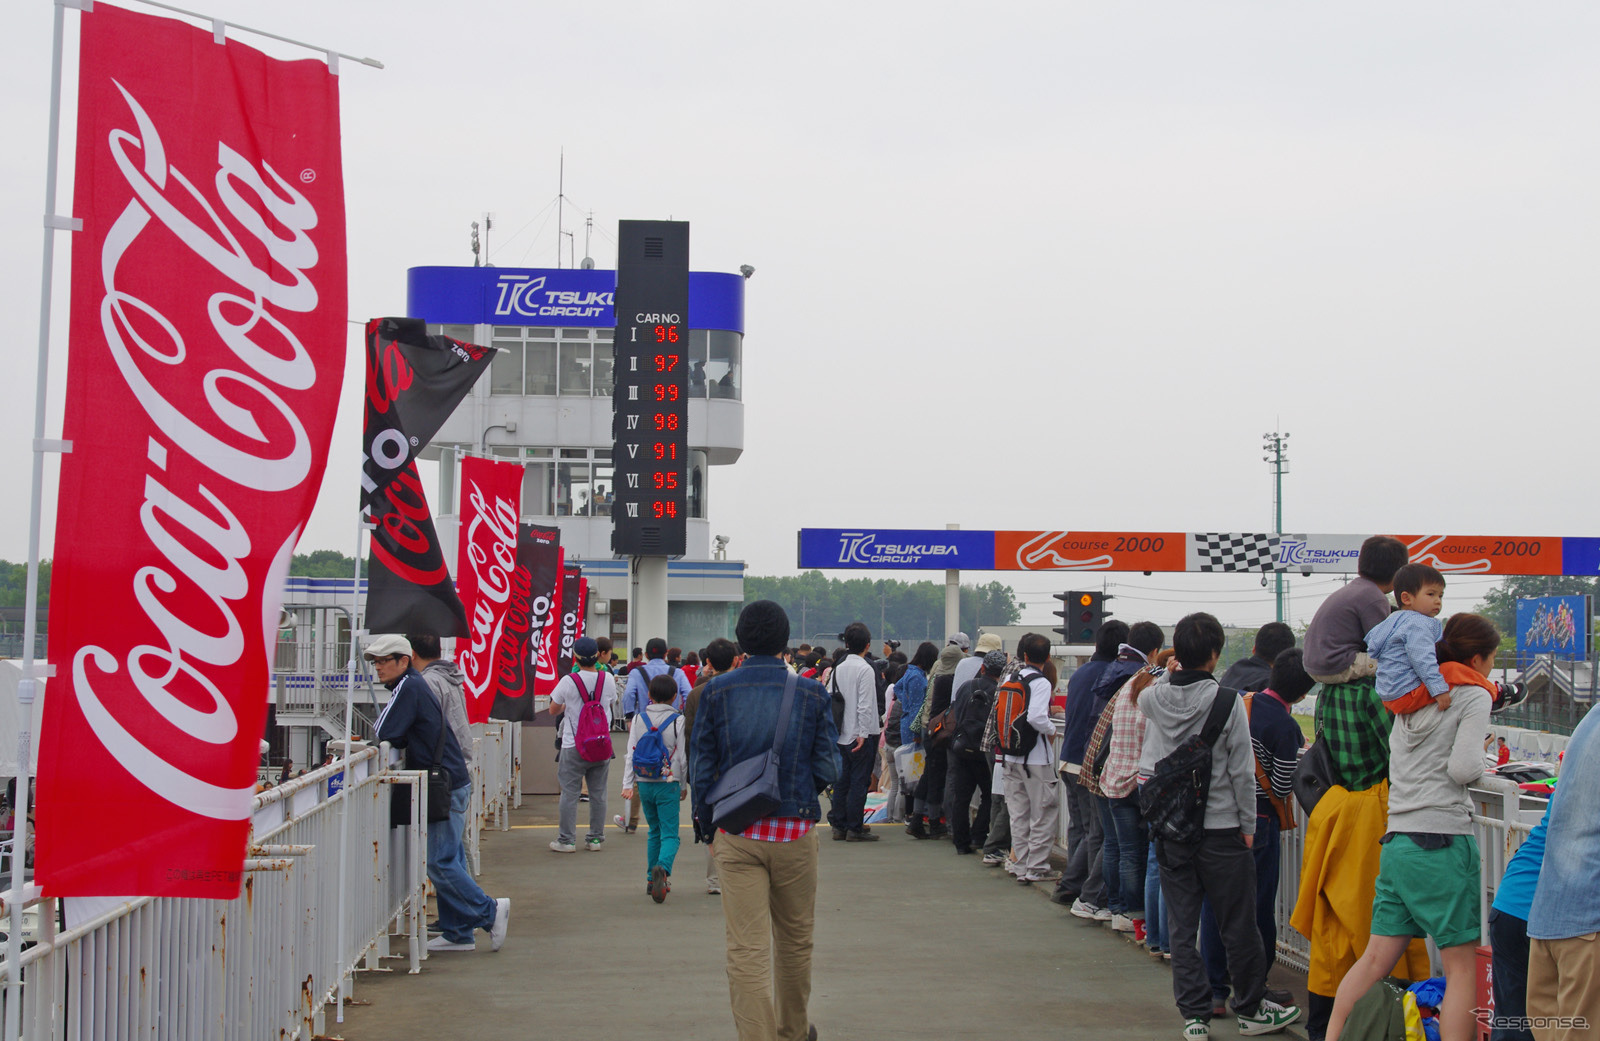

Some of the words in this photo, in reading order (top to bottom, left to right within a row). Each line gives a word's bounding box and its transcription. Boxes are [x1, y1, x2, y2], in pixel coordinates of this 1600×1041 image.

[635, 313, 660, 324] CAR
[661, 313, 681, 324] NO.
[654, 325, 679, 343] 96
[654, 354, 679, 372] 97
[653, 384, 679, 401] 99
[653, 413, 678, 431] 98
[72, 77, 320, 821] Coca-Cola
[653, 442, 676, 460] 91
[653, 472, 677, 489] 95
[652, 501, 677, 519] 94
[874, 544, 959, 556] TSUKUBA
[1062, 541, 1110, 550] course
[1113, 537, 1165, 553] 2000
[1306, 549, 1360, 558] TSUKUB
[1441, 543, 1487, 554] course
[1491, 541, 1541, 557] 2000
[560, 612, 578, 659] zero
[1189, 1026, 1208, 1035] NIKE
